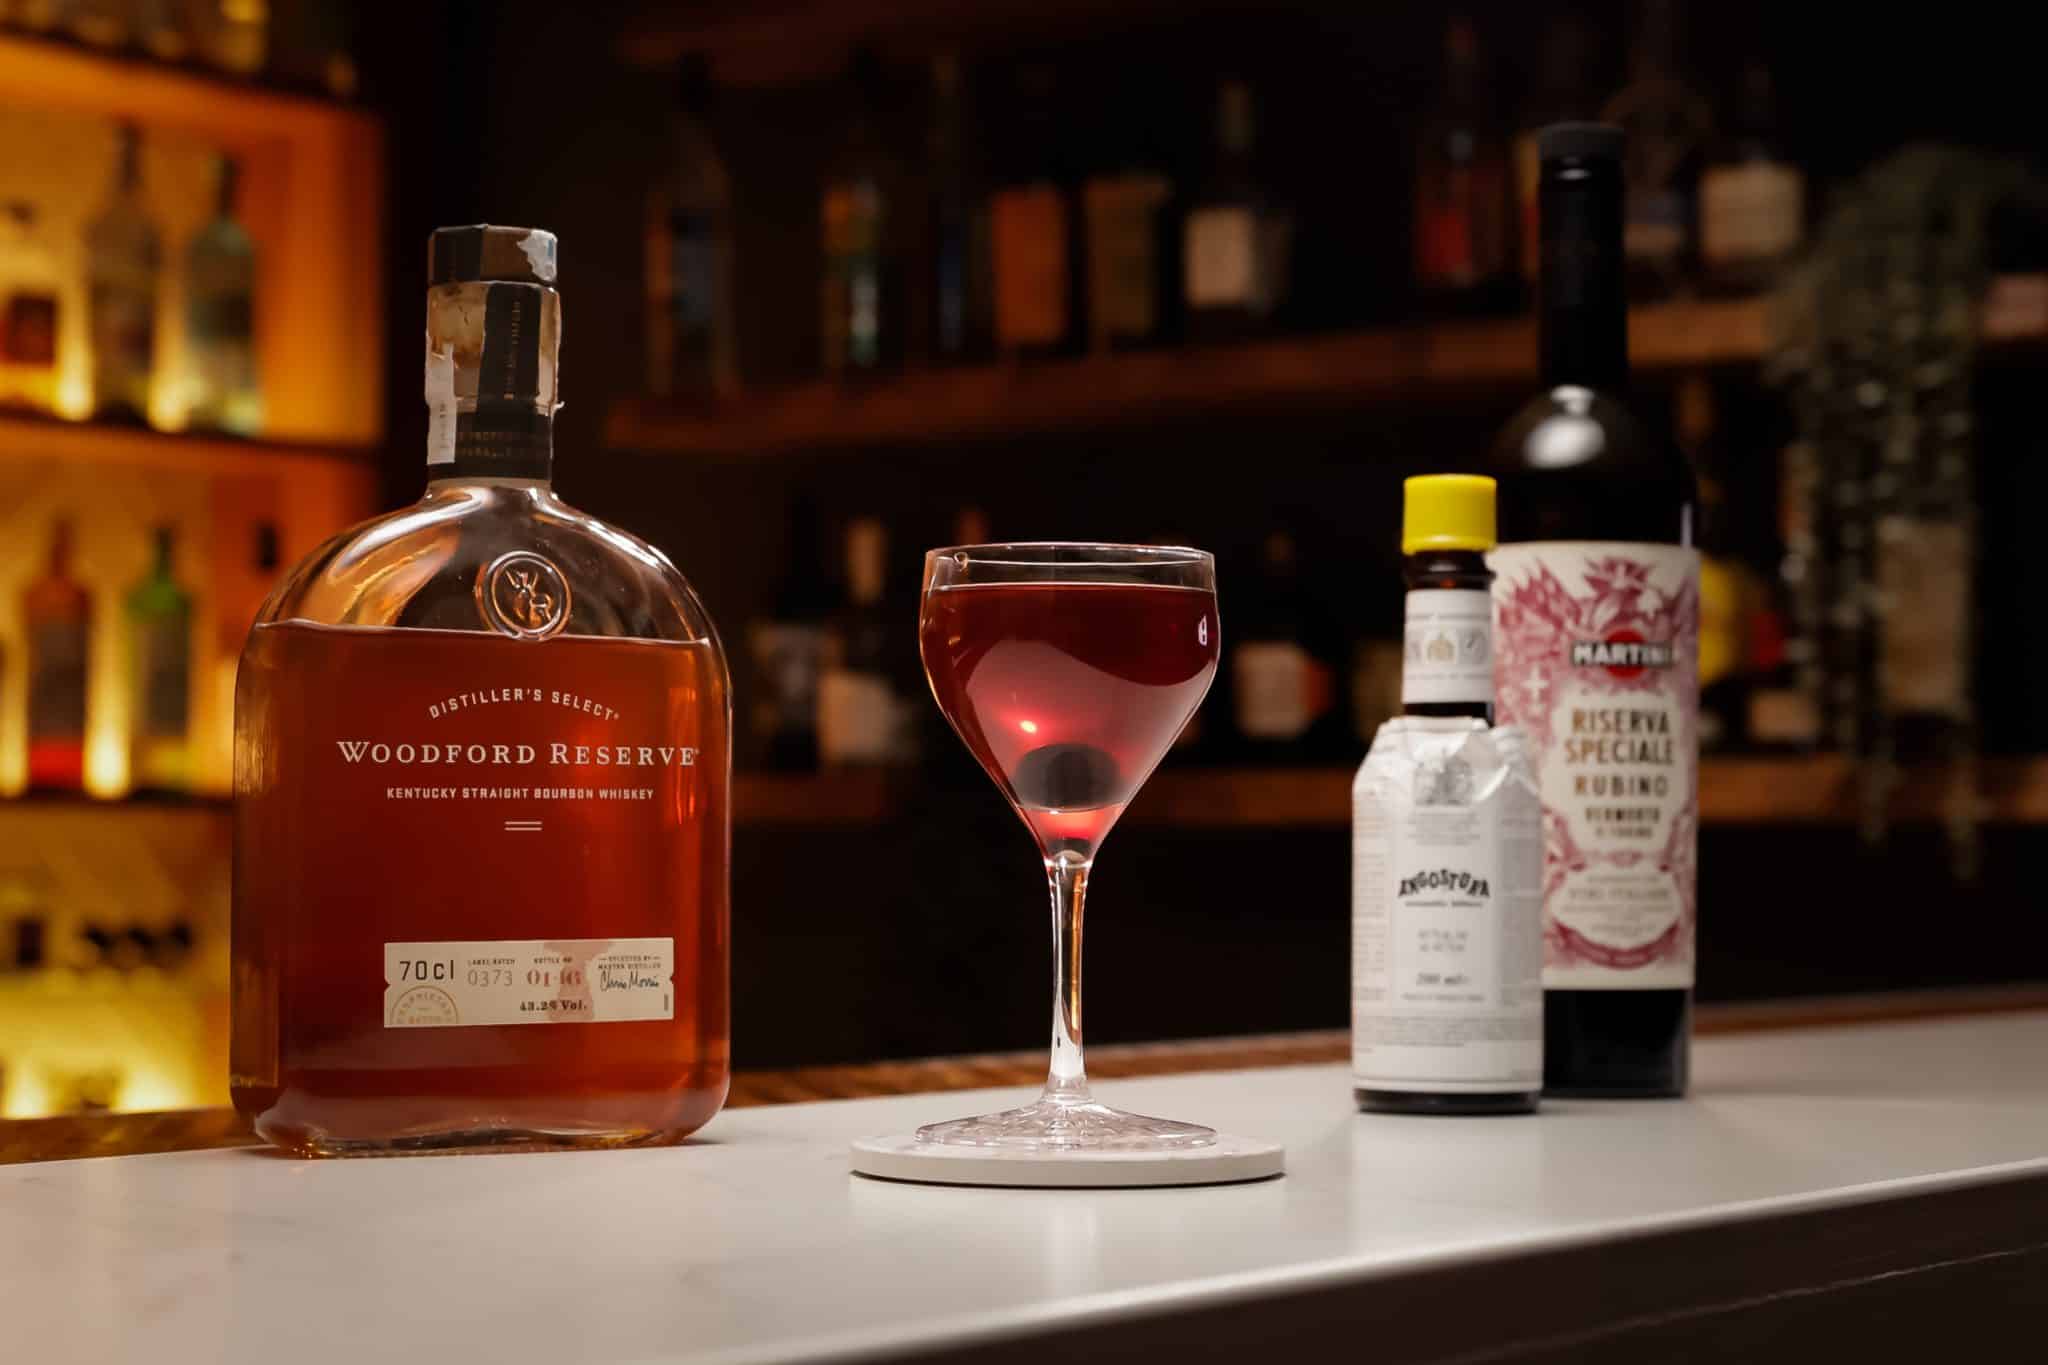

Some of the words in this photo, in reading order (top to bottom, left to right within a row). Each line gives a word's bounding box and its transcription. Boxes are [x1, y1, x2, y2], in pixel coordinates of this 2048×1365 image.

[429, 688, 542, 719] DISTILLER'S
[1571, 708, 1669, 733] RISERVA
[337, 741, 536, 765] WOODFORD
[1564, 738, 1673, 764] SPECIALE
[387, 787, 457, 800] KENTUCKY
[462, 787, 529, 800] STRAIGHT
[534, 788, 594, 800] BOURBON
[599, 788, 654, 800] WHISKEY
[1573, 775, 1668, 796] RUBINO
[1398, 868, 1490, 898] ANGOSTURA
[399, 959, 454, 981] 70cl
[467, 968, 513, 988] 0373
[560, 999, 587, 1012] Vol.
